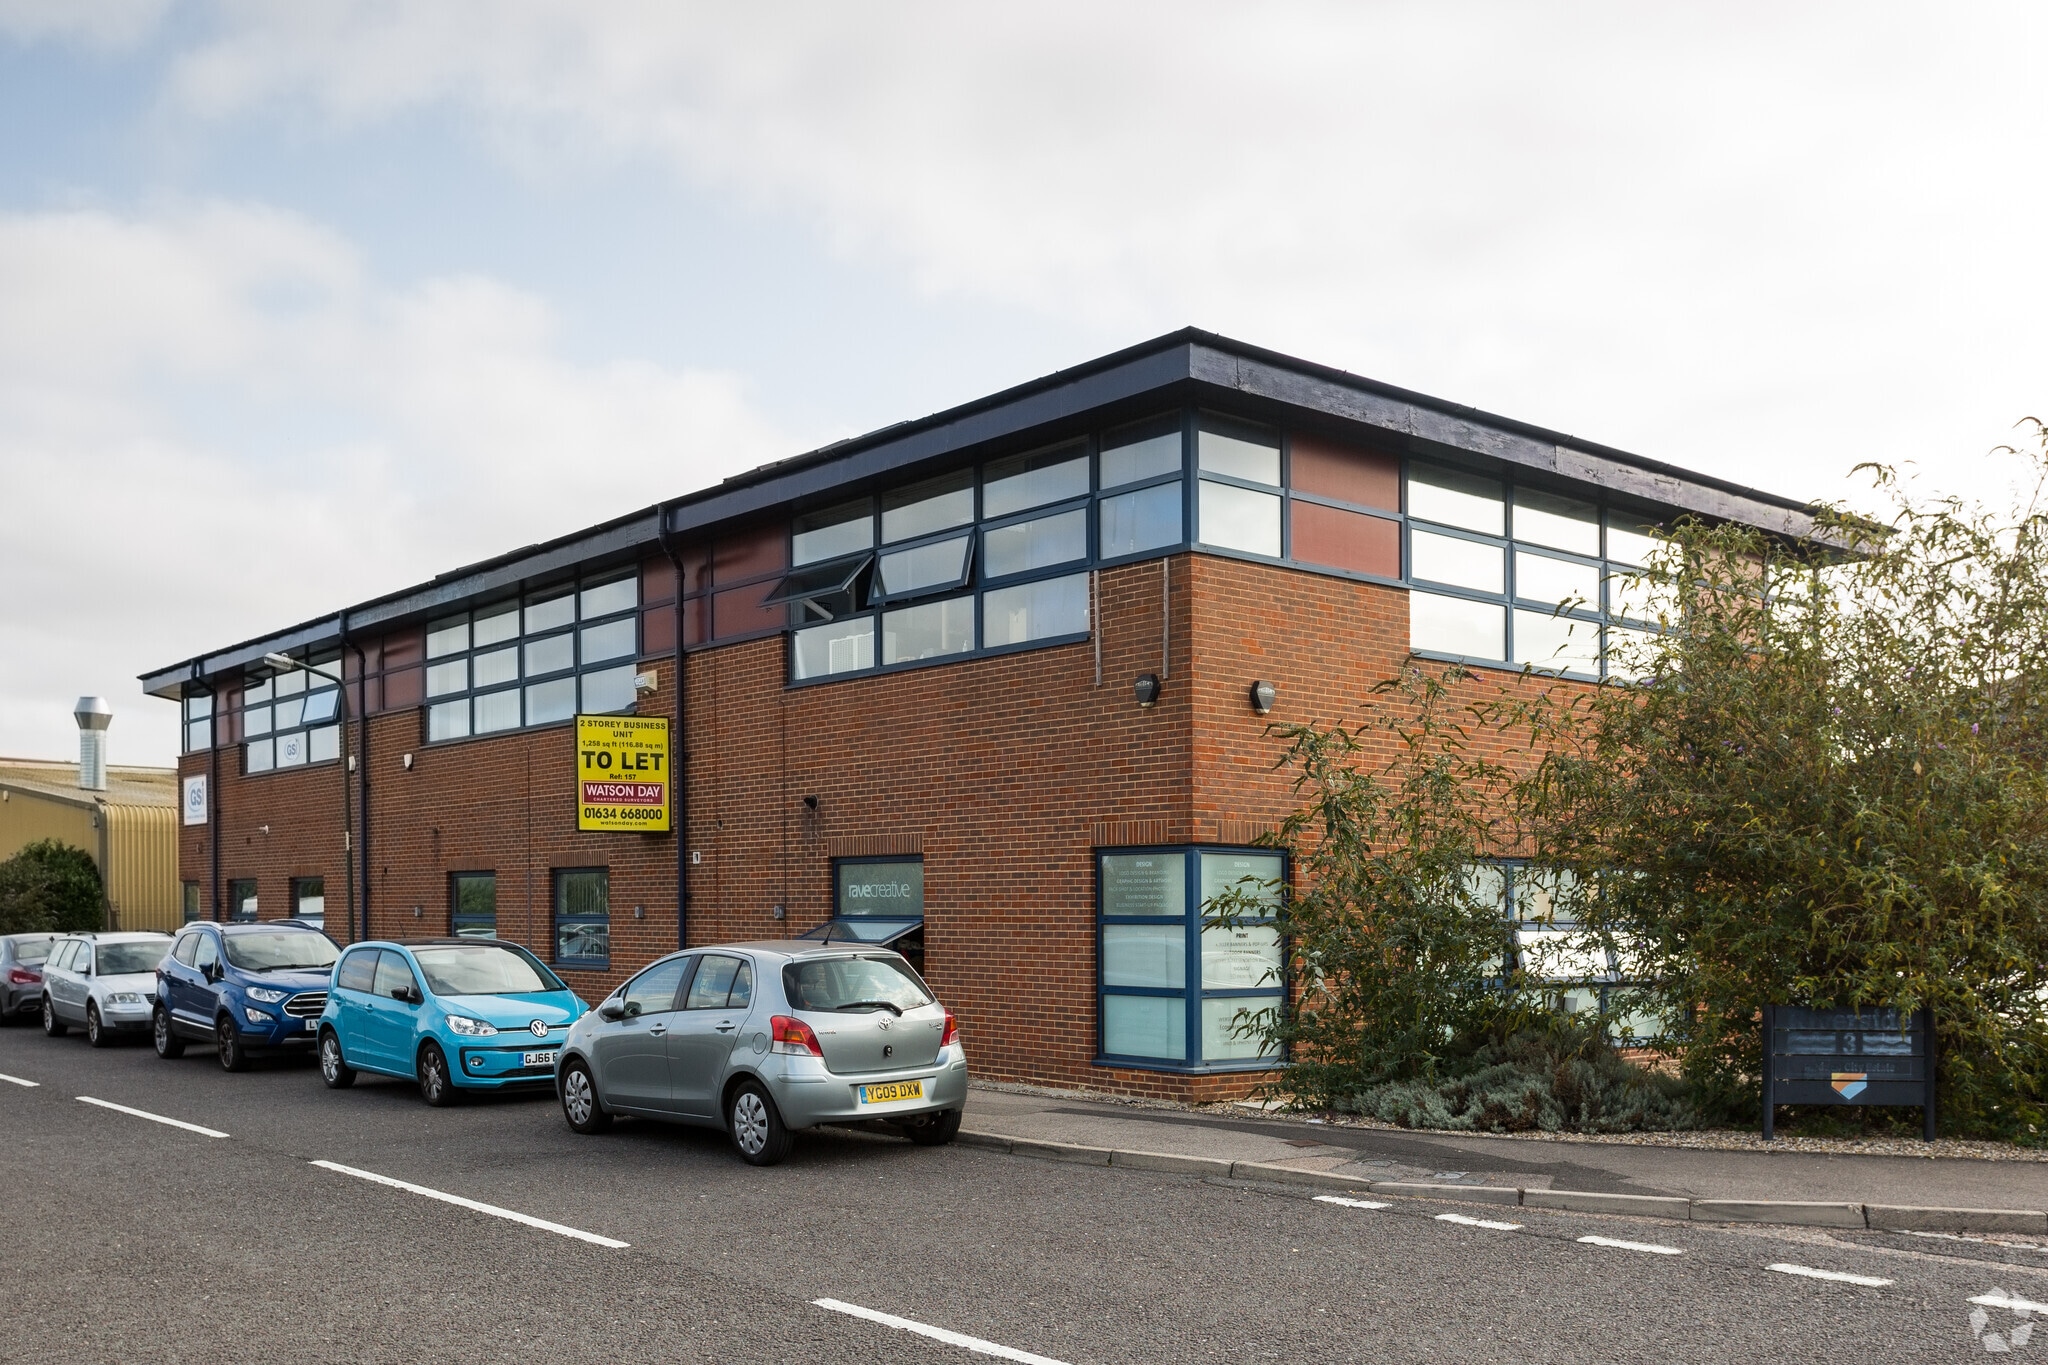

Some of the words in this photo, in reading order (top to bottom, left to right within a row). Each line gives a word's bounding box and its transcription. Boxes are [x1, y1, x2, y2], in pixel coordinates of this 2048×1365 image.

[588, 720, 621, 728] STOREY
[624, 721, 666, 730] BUSINESS
[582, 751, 612, 769] TO
[622, 752, 664, 770] LET
[586, 784, 634, 796] WATSON
[638, 786, 660, 797] DAY
[584, 807, 617, 819] 01634
[620, 809, 663, 820] 668000
[849, 881, 910, 898] ravecreative
[1843, 1033, 1857, 1054] 3
[525, 1053, 550, 1064] GJ66
[1844, 1061, 1864, 1074] City
[868, 1085, 897, 1100] YG09
[899, 1083, 920, 1097] DXW
